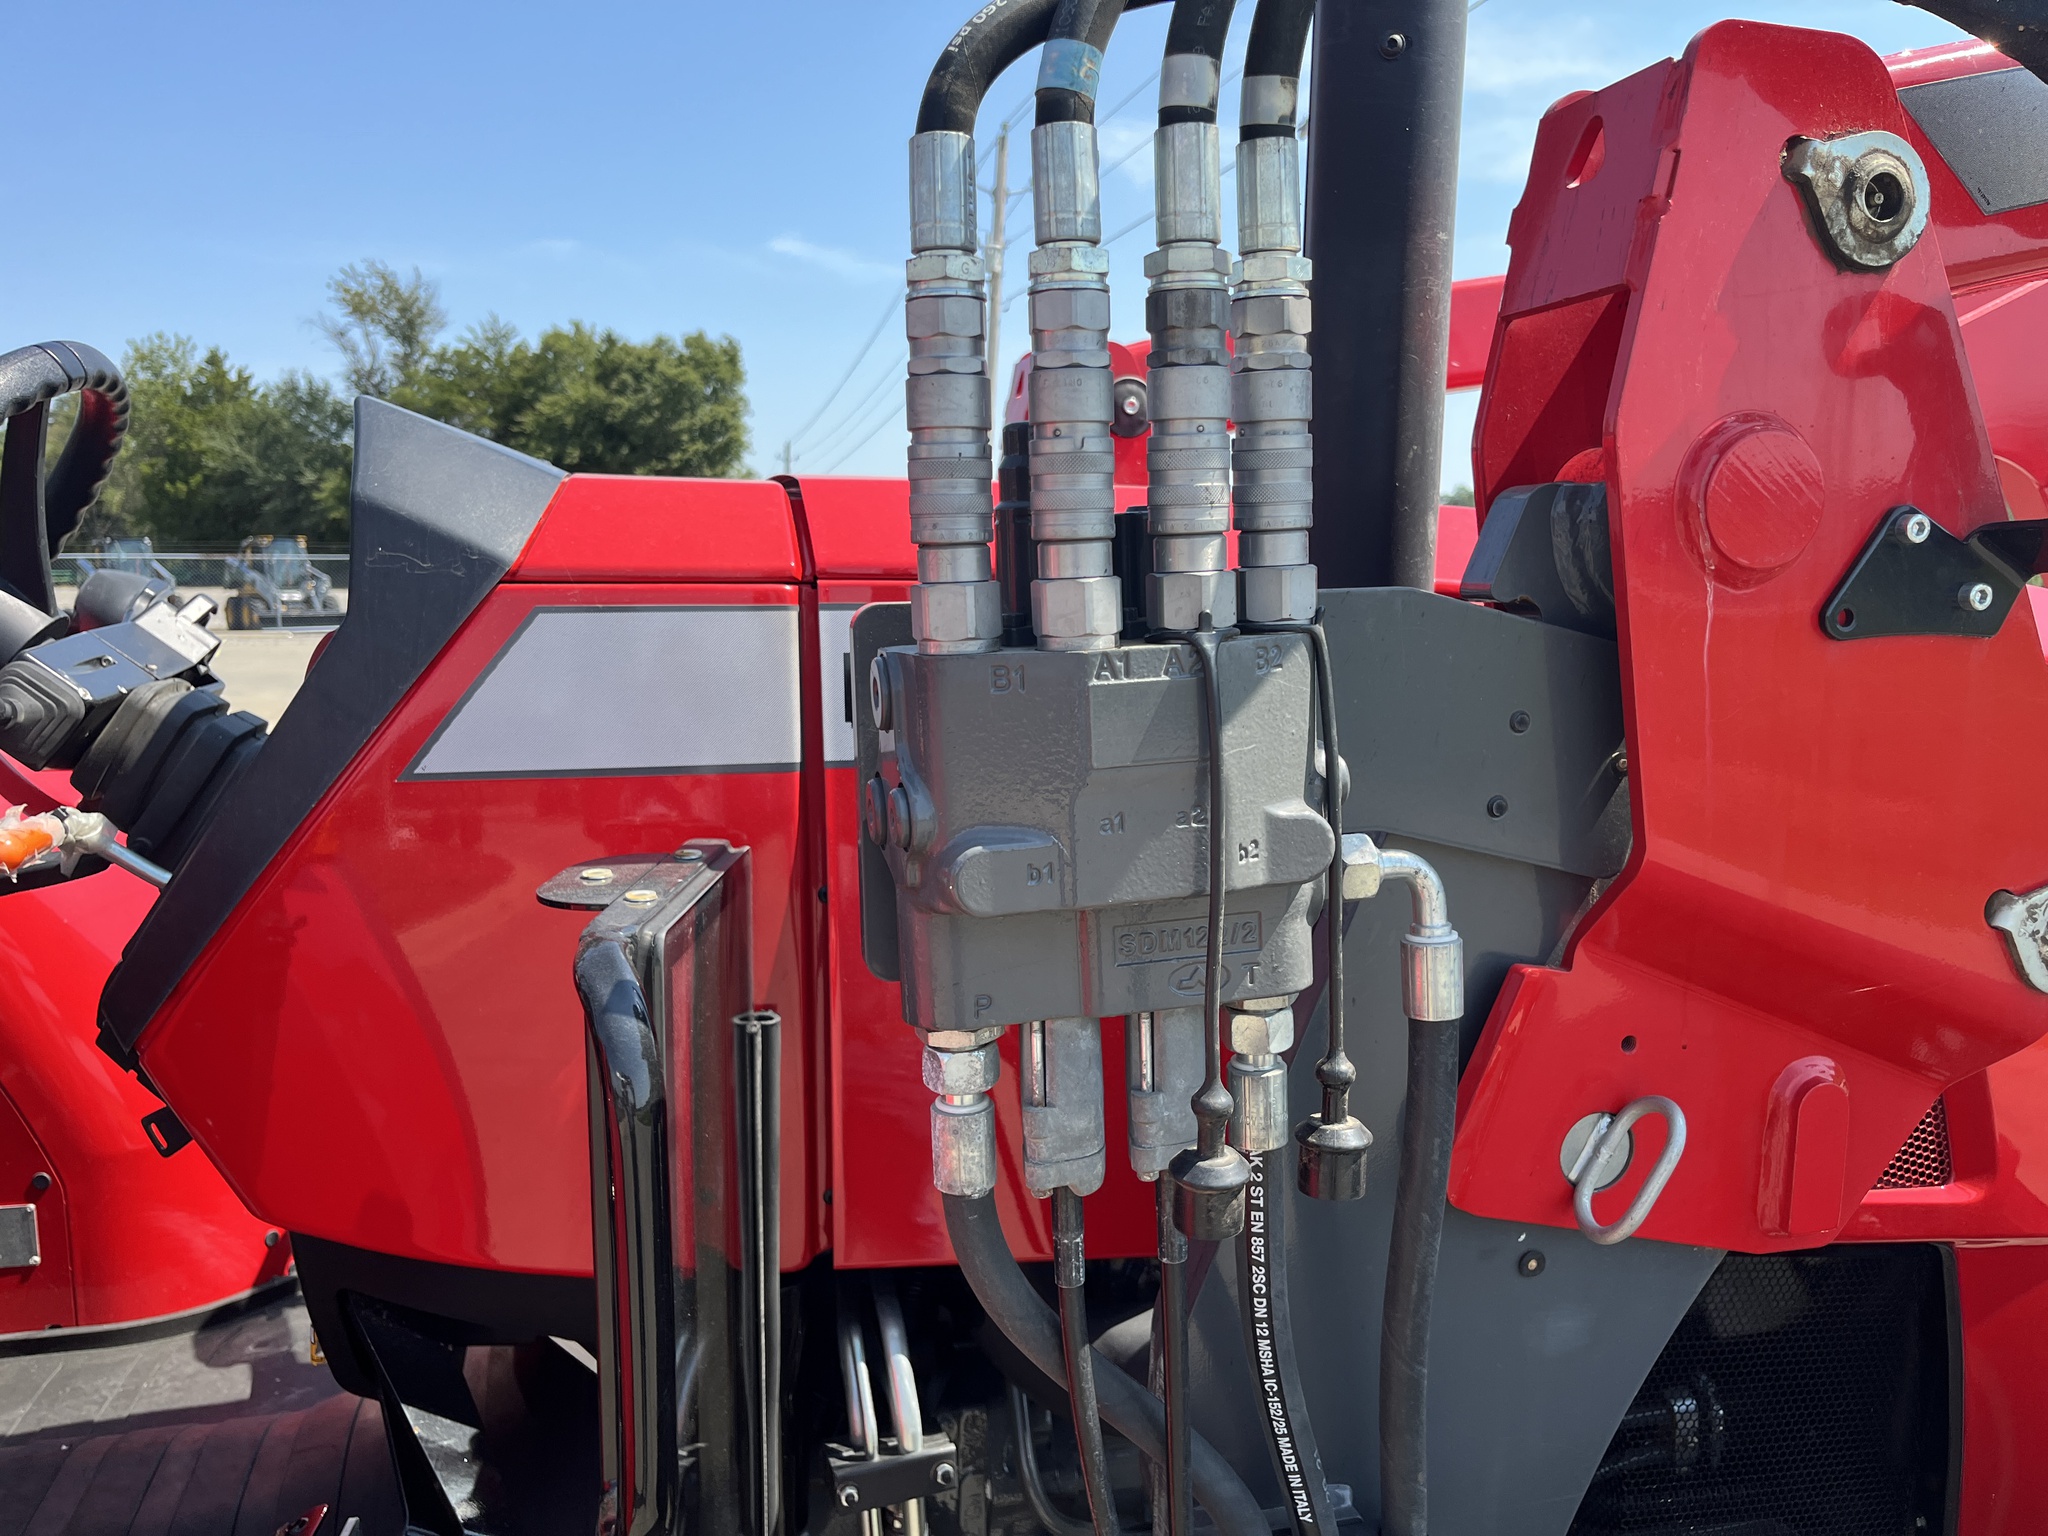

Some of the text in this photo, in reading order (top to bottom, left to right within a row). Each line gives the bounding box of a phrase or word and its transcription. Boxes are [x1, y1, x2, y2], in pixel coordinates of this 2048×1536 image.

[947, 26, 972, 53] psi
[1092, 649, 1130, 681] A1
[1255, 644, 1283, 675] B2
[990, 664, 1025, 694] B1
[1099, 810, 1125, 836] a1
[1175, 804, 1208, 829] a2
[1238, 838, 1260, 865] b2
[1026, 861, 1054, 886] b1
[1118, 921, 1258, 957] SDM12/2
[1241, 961, 1261, 986] T
[974, 994, 992, 1020] P
[1250, 1172, 1263, 1182] 2
[1250, 1186, 1264, 1208] ST
[1250, 1211, 1265, 1233] EN
[1250, 1236, 1265, 1263] 857
[1251, 1265, 1266, 1295] 2SC
[1253, 1297, 1268, 1318] DN
[1255, 1321, 1269, 1337] 12
[1257, 1338, 1275, 1377] MSHA
[1263, 1378, 1288, 1435] IC-152/25
[1276, 1436, 1299, 1472] MADE
[1287, 1474, 1304, 1488] IN
[1291, 1489, 1314, 1523] ITALY
